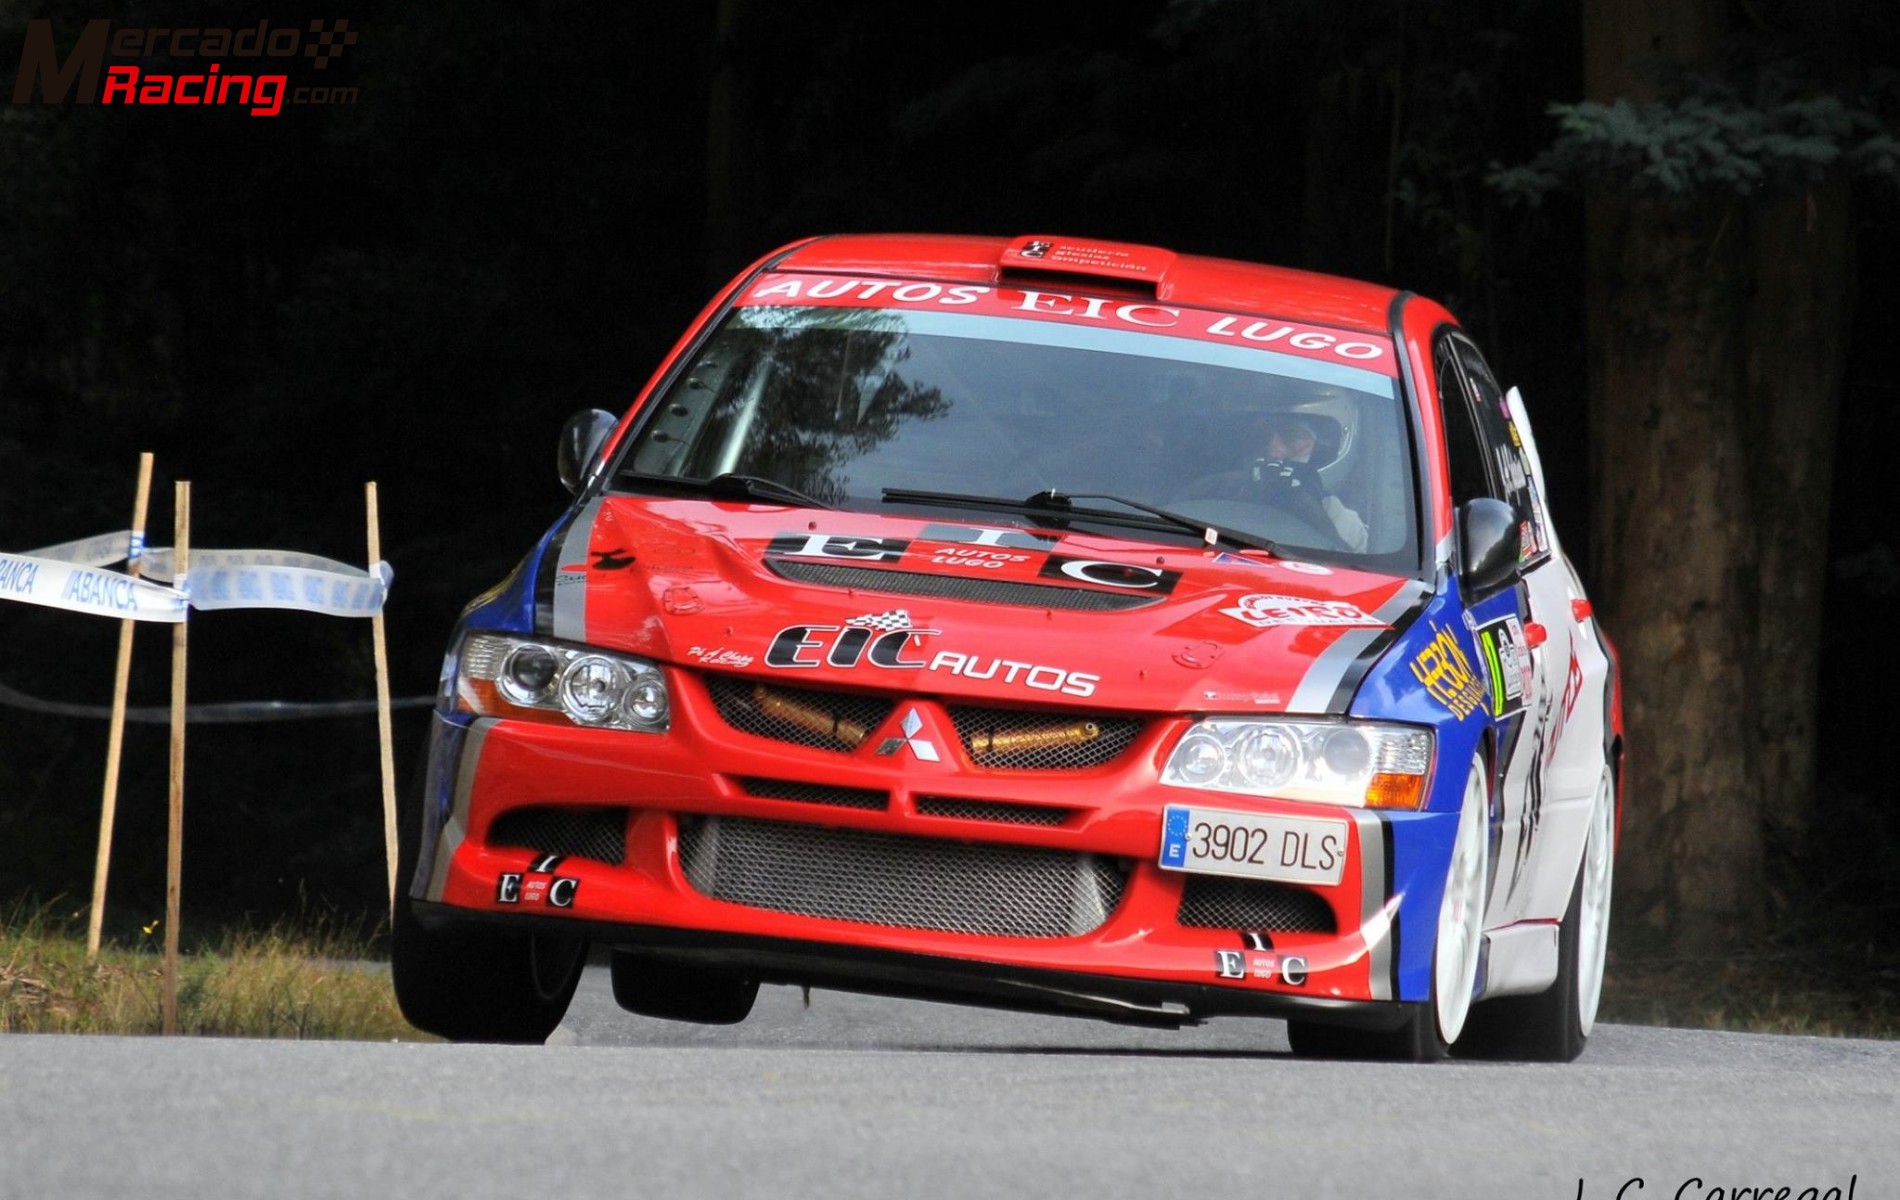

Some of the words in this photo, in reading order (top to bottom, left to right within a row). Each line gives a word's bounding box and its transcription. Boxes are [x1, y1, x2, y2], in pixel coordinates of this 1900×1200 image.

[755, 278, 992, 306] AUTOS
[1011, 289, 1182, 327] EIC
[1208, 316, 1383, 360] LUGO
[931, 556, 1004, 569] LUGO
[935, 547, 1032, 562] AUTOS
[66, 568, 139, 612] ABANCA
[764, 624, 942, 669] EIC
[928, 650, 1101, 699] AUTOS
[1169, 843, 1181, 858] E
[1192, 822, 1268, 865] 3902
[1280, 830, 1337, 870] DLS
